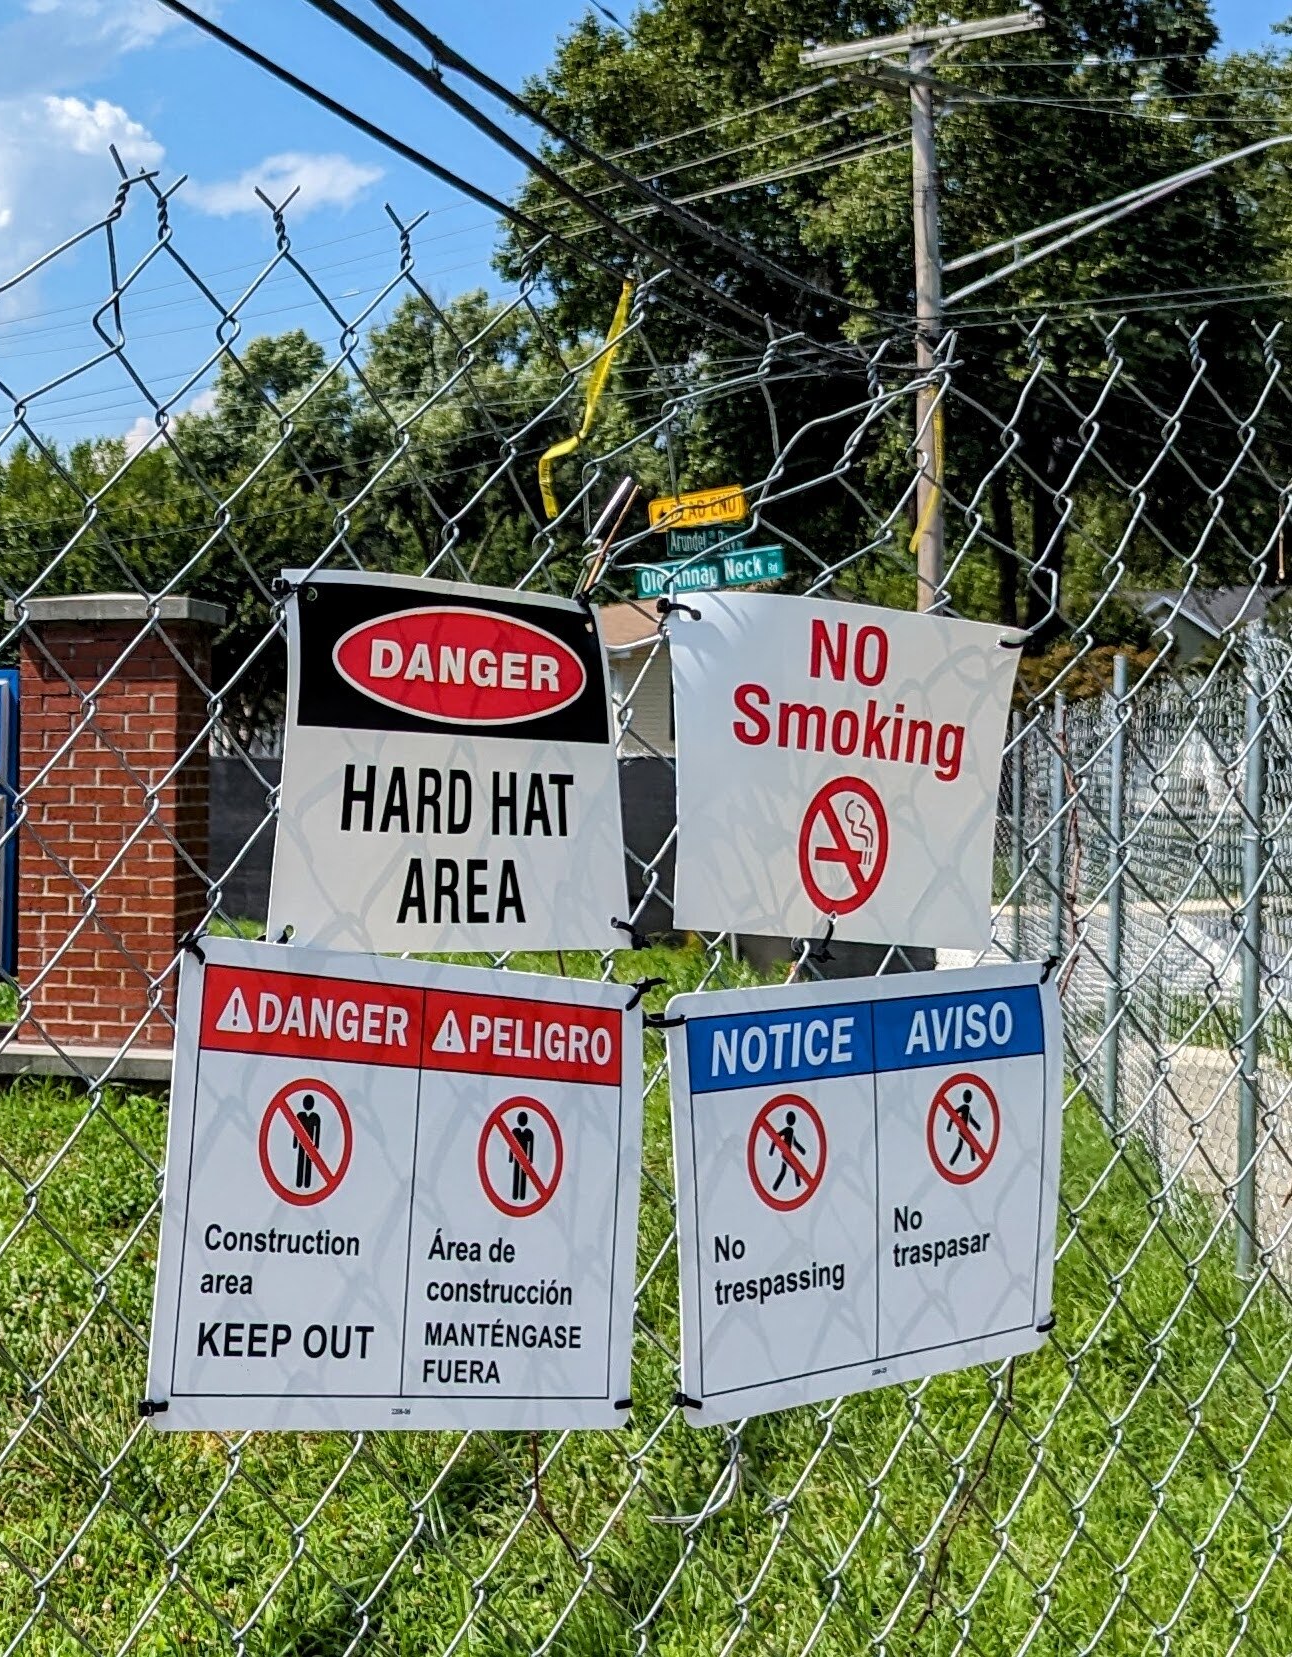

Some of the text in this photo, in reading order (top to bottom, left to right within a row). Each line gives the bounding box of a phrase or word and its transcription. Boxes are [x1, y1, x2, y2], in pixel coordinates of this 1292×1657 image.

[670, 530, 707, 552] Arundel
[672, 566, 719, 588] Annap
[724, 555, 763, 581] Neck
[768, 562, 778, 574] Rd
[369, 639, 560, 692] DANGER
[809, 619, 889, 687] NO
[733, 684, 965, 781] Smoking
[340, 764, 574, 837] HARD HAT
[396, 858, 526, 924] AREA
[258, 991, 409, 1047] DANGER
[905, 1002, 1013, 1055] AVISO
[470, 1015, 612, 1066] PELIGRO
[711, 1017, 855, 1077] NOTICE
[894, 1206, 923, 1233] No
[204, 1224, 360, 1256] Construction
[428, 1228, 516, 1263] Área de
[714, 1234, 745, 1263] No
[893, 1231, 991, 1269] traspasar
[200, 1273, 253, 1295] area
[426, 1279, 573, 1306] construcción
[715, 1261, 846, 1306] trespassing
[197, 1322, 375, 1360] KEEP OUT
[424, 1318, 582, 1349] MANTÉNGASE
[422, 1360, 501, 1384] FUERA
